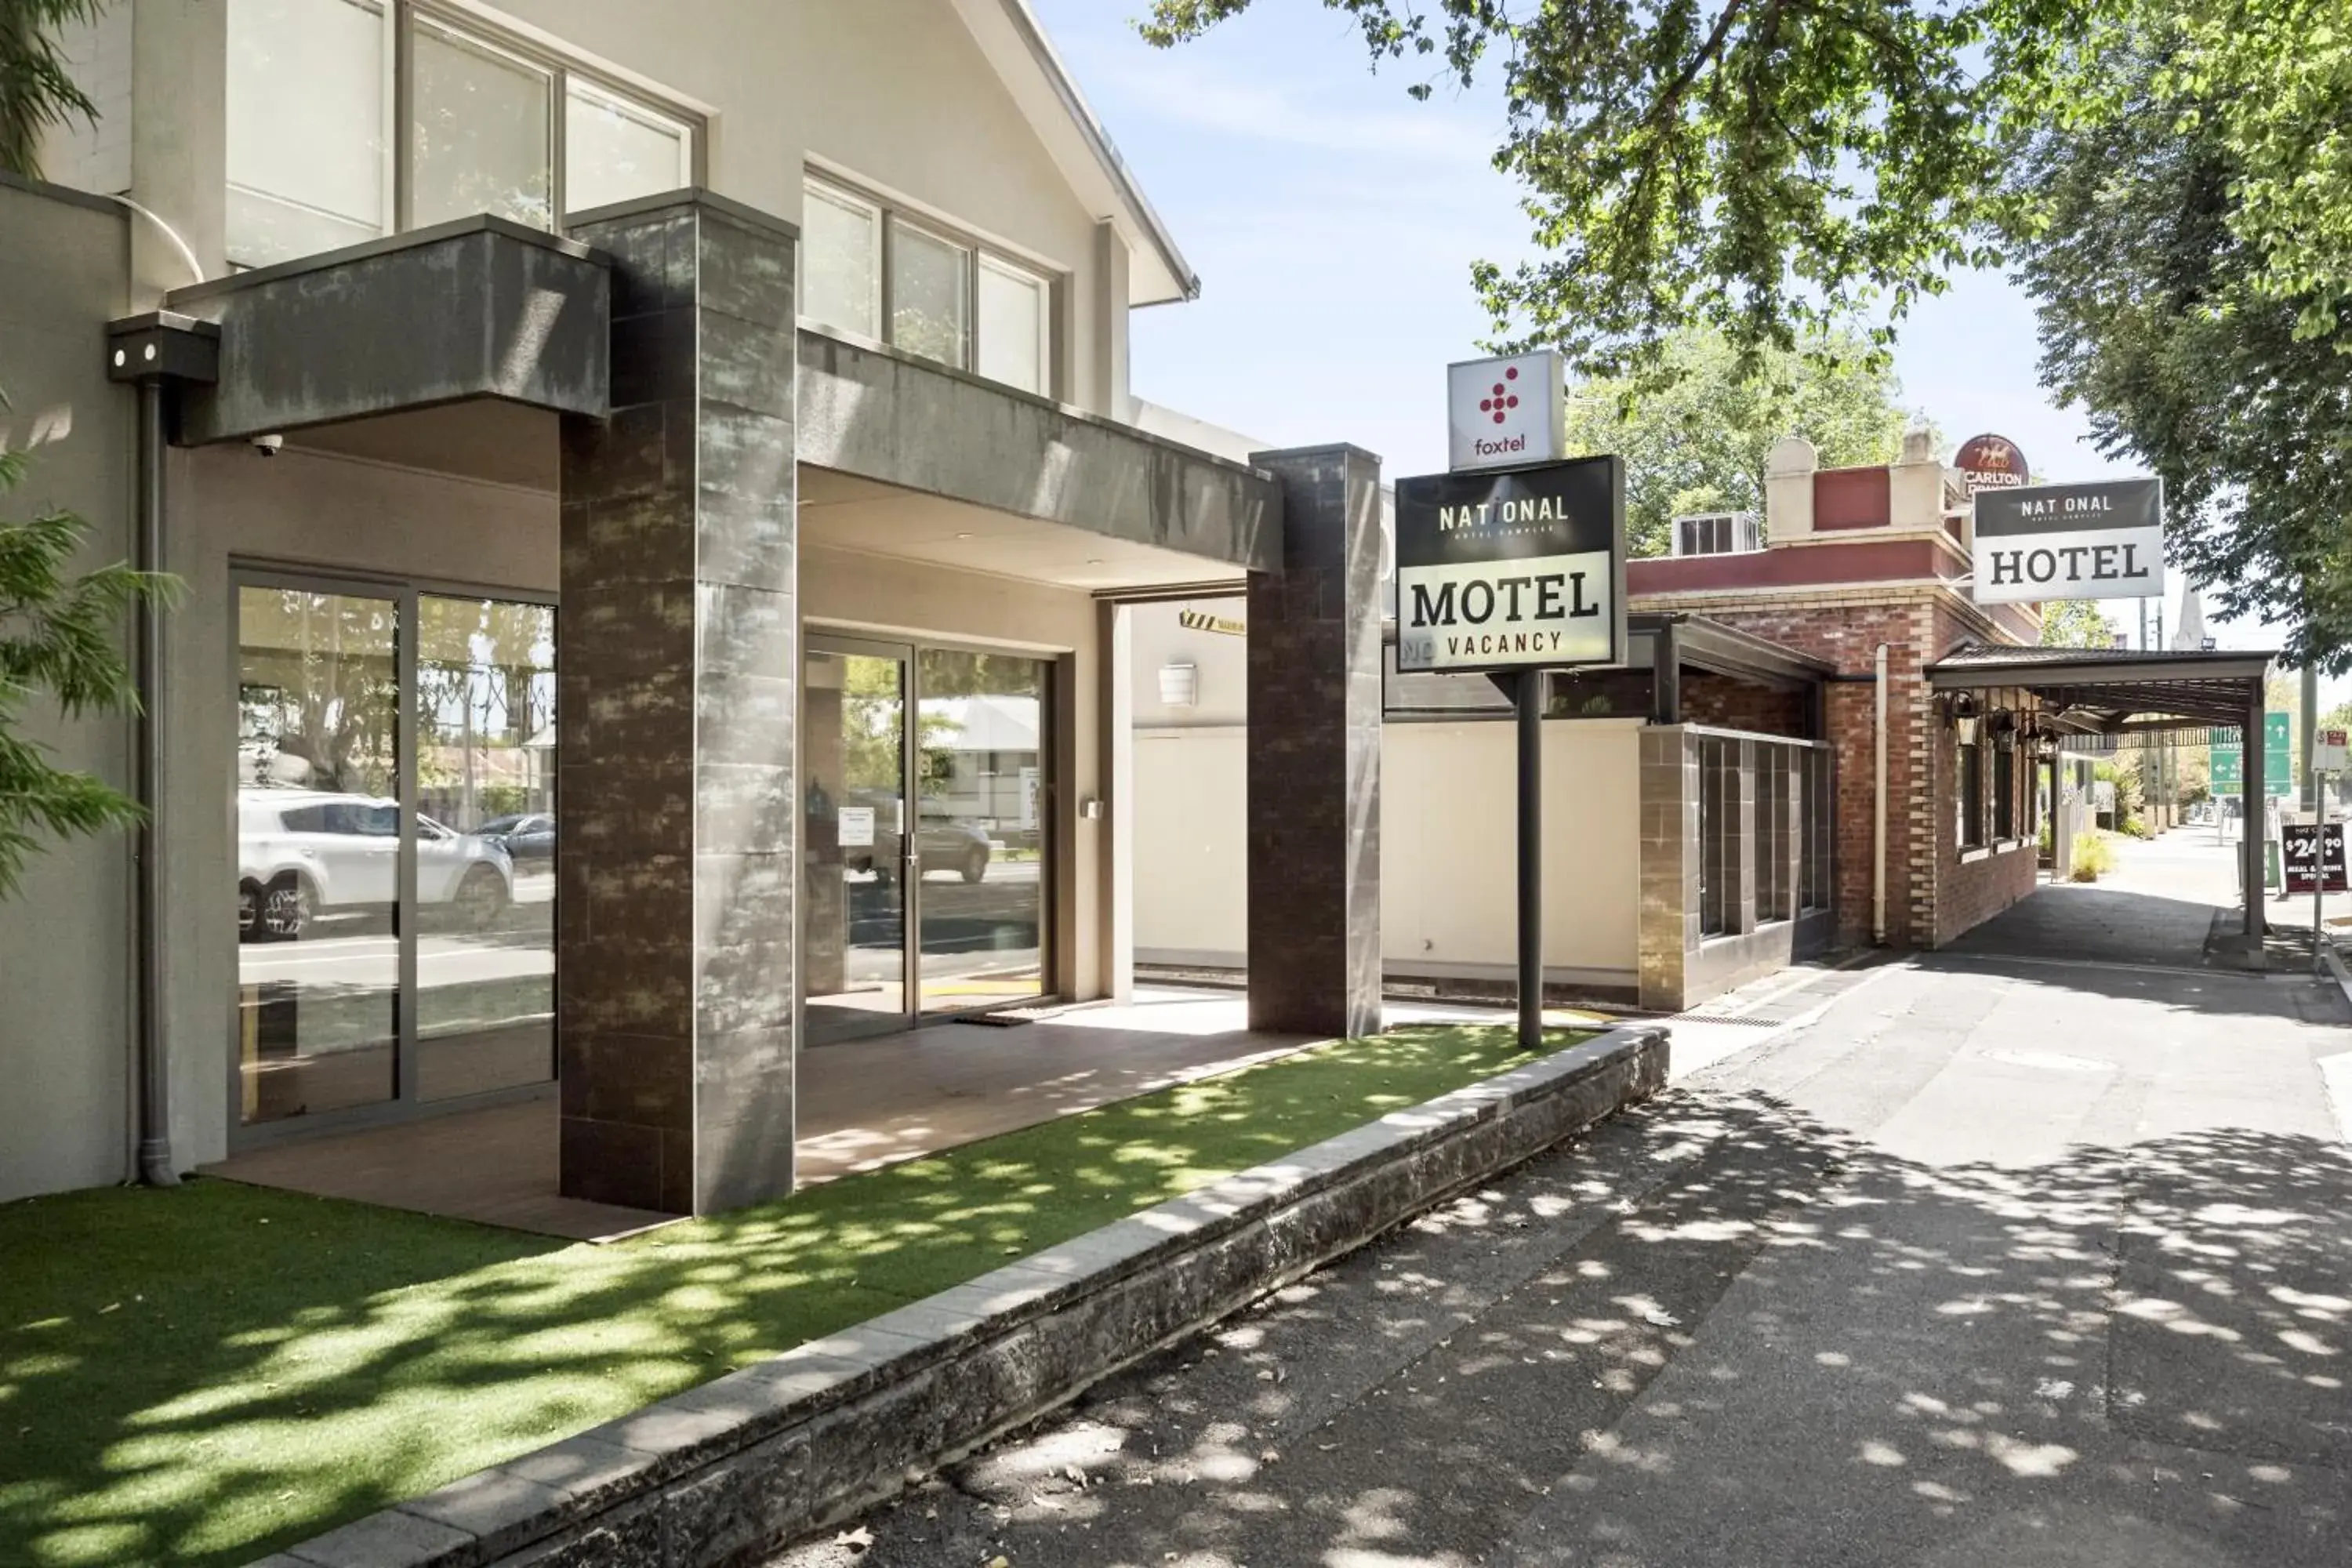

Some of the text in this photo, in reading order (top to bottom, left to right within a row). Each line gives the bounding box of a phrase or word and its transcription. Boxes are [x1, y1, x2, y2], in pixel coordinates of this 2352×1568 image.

[1475, 434, 1525, 456] foxtel
[1965, 471, 2022, 486] CARLTON
[2022, 495, 2114, 516] NATONAL
[1991, 543, 2148, 585] HOTEL
[1410, 572, 1599, 627] MOTEL
[1448, 631, 1561, 655] VACANCY
